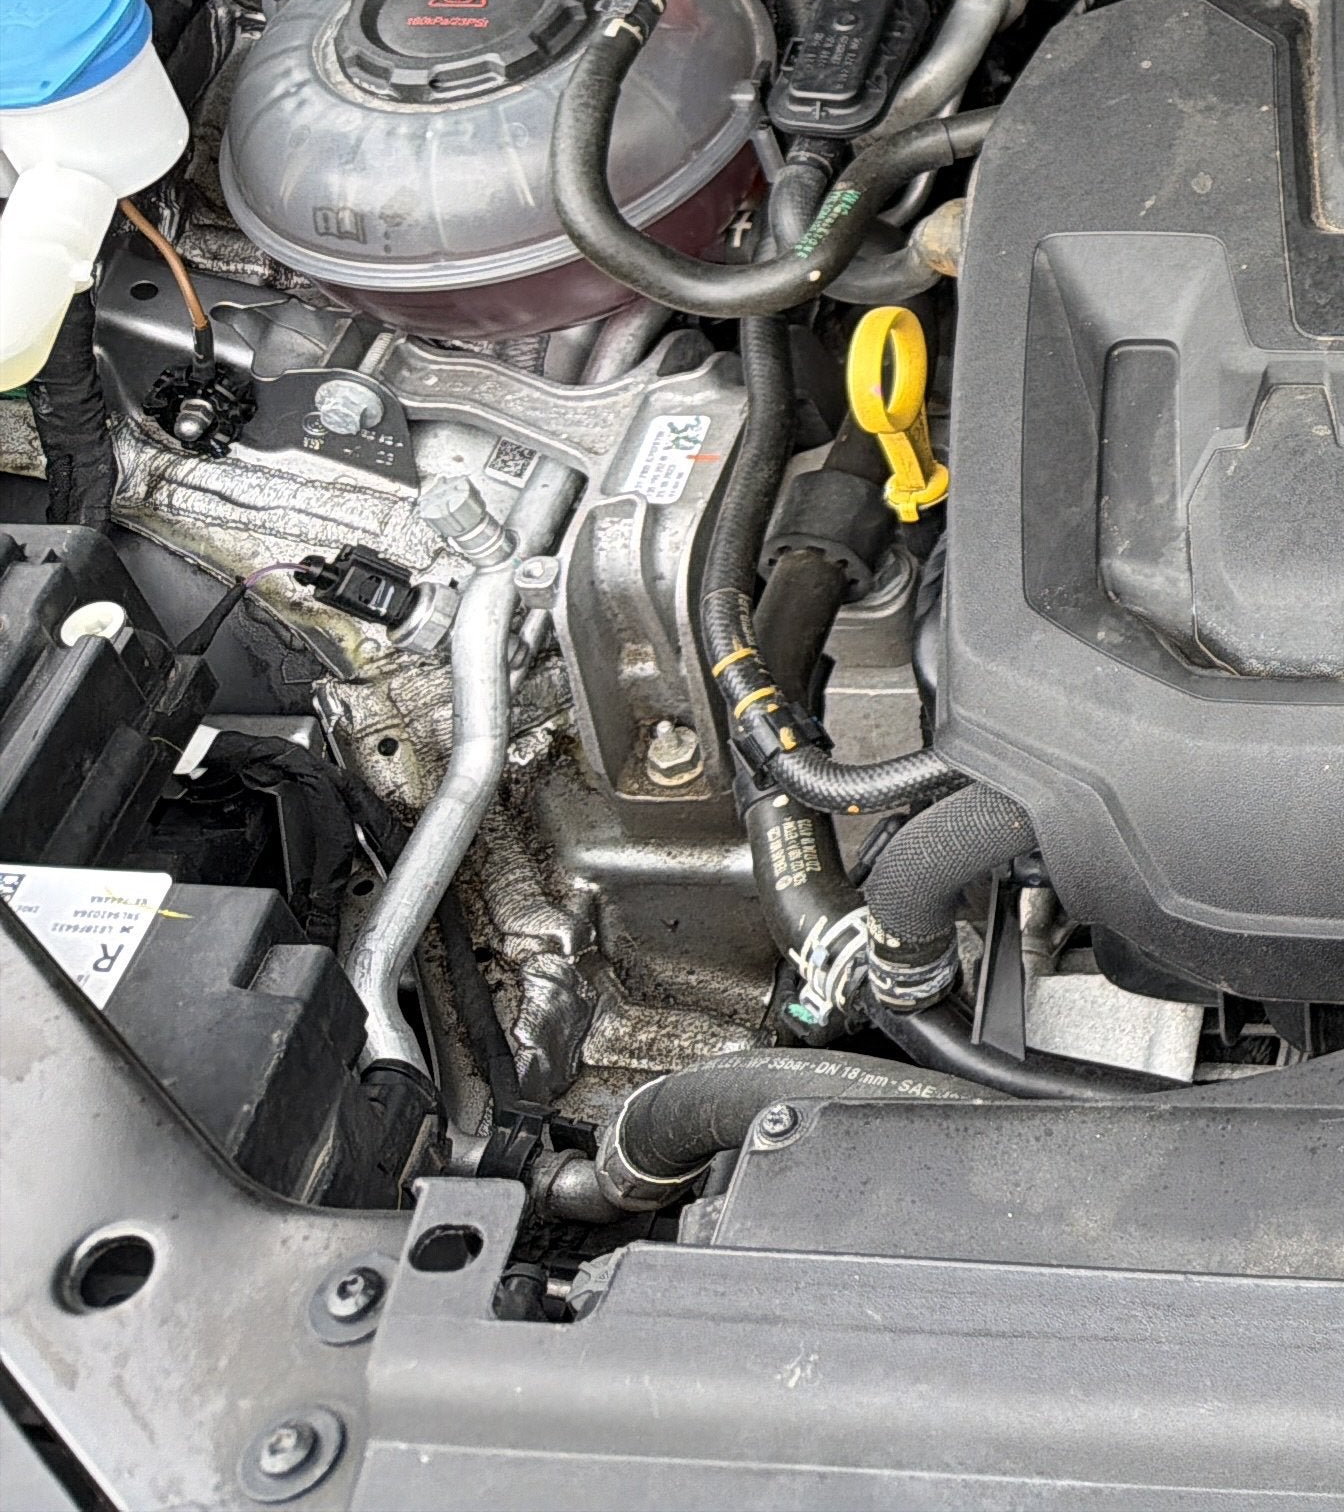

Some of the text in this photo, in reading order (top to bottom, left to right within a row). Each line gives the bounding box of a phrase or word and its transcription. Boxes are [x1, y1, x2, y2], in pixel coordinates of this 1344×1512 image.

[92, 944, 125, 973] R
[814, 1061, 842, 1076] DN
[840, 1066, 861, 1080] 18
[897, 1079, 937, 1099] SAE
